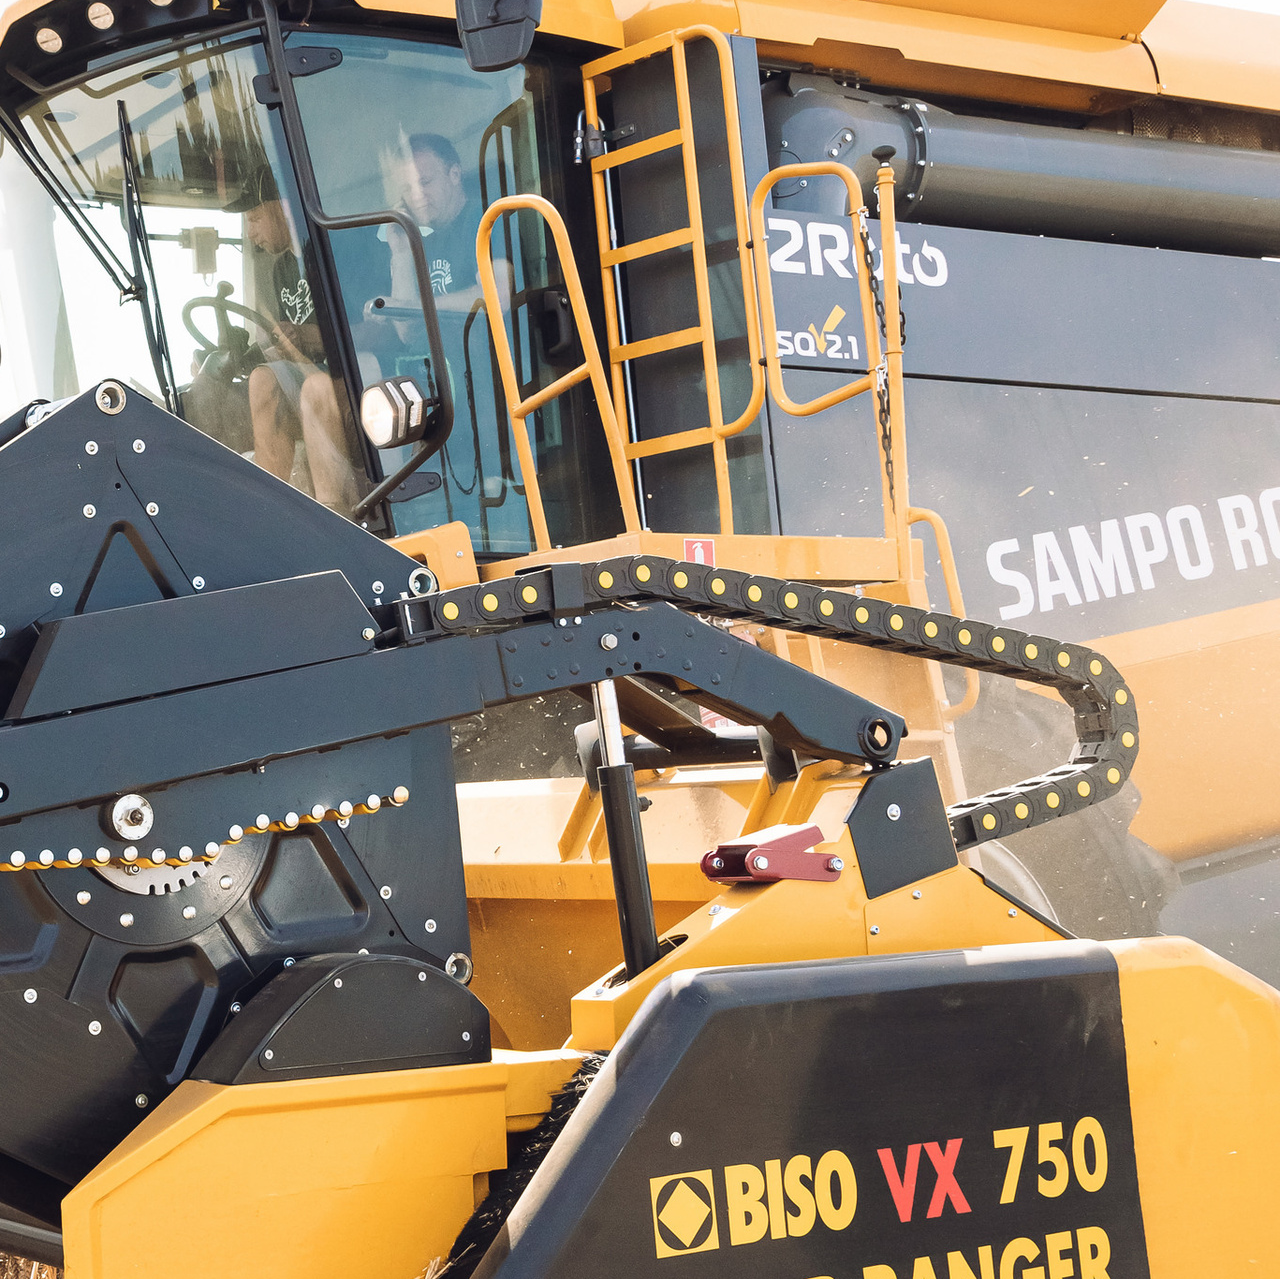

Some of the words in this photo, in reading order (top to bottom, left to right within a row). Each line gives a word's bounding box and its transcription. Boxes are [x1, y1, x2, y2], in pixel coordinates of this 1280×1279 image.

[986, 505, 1214, 621] SAMPO
[724, 1149, 857, 1246] BISO
[877, 1138, 972, 1223] VX
[993, 1116, 1108, 1204] 750
